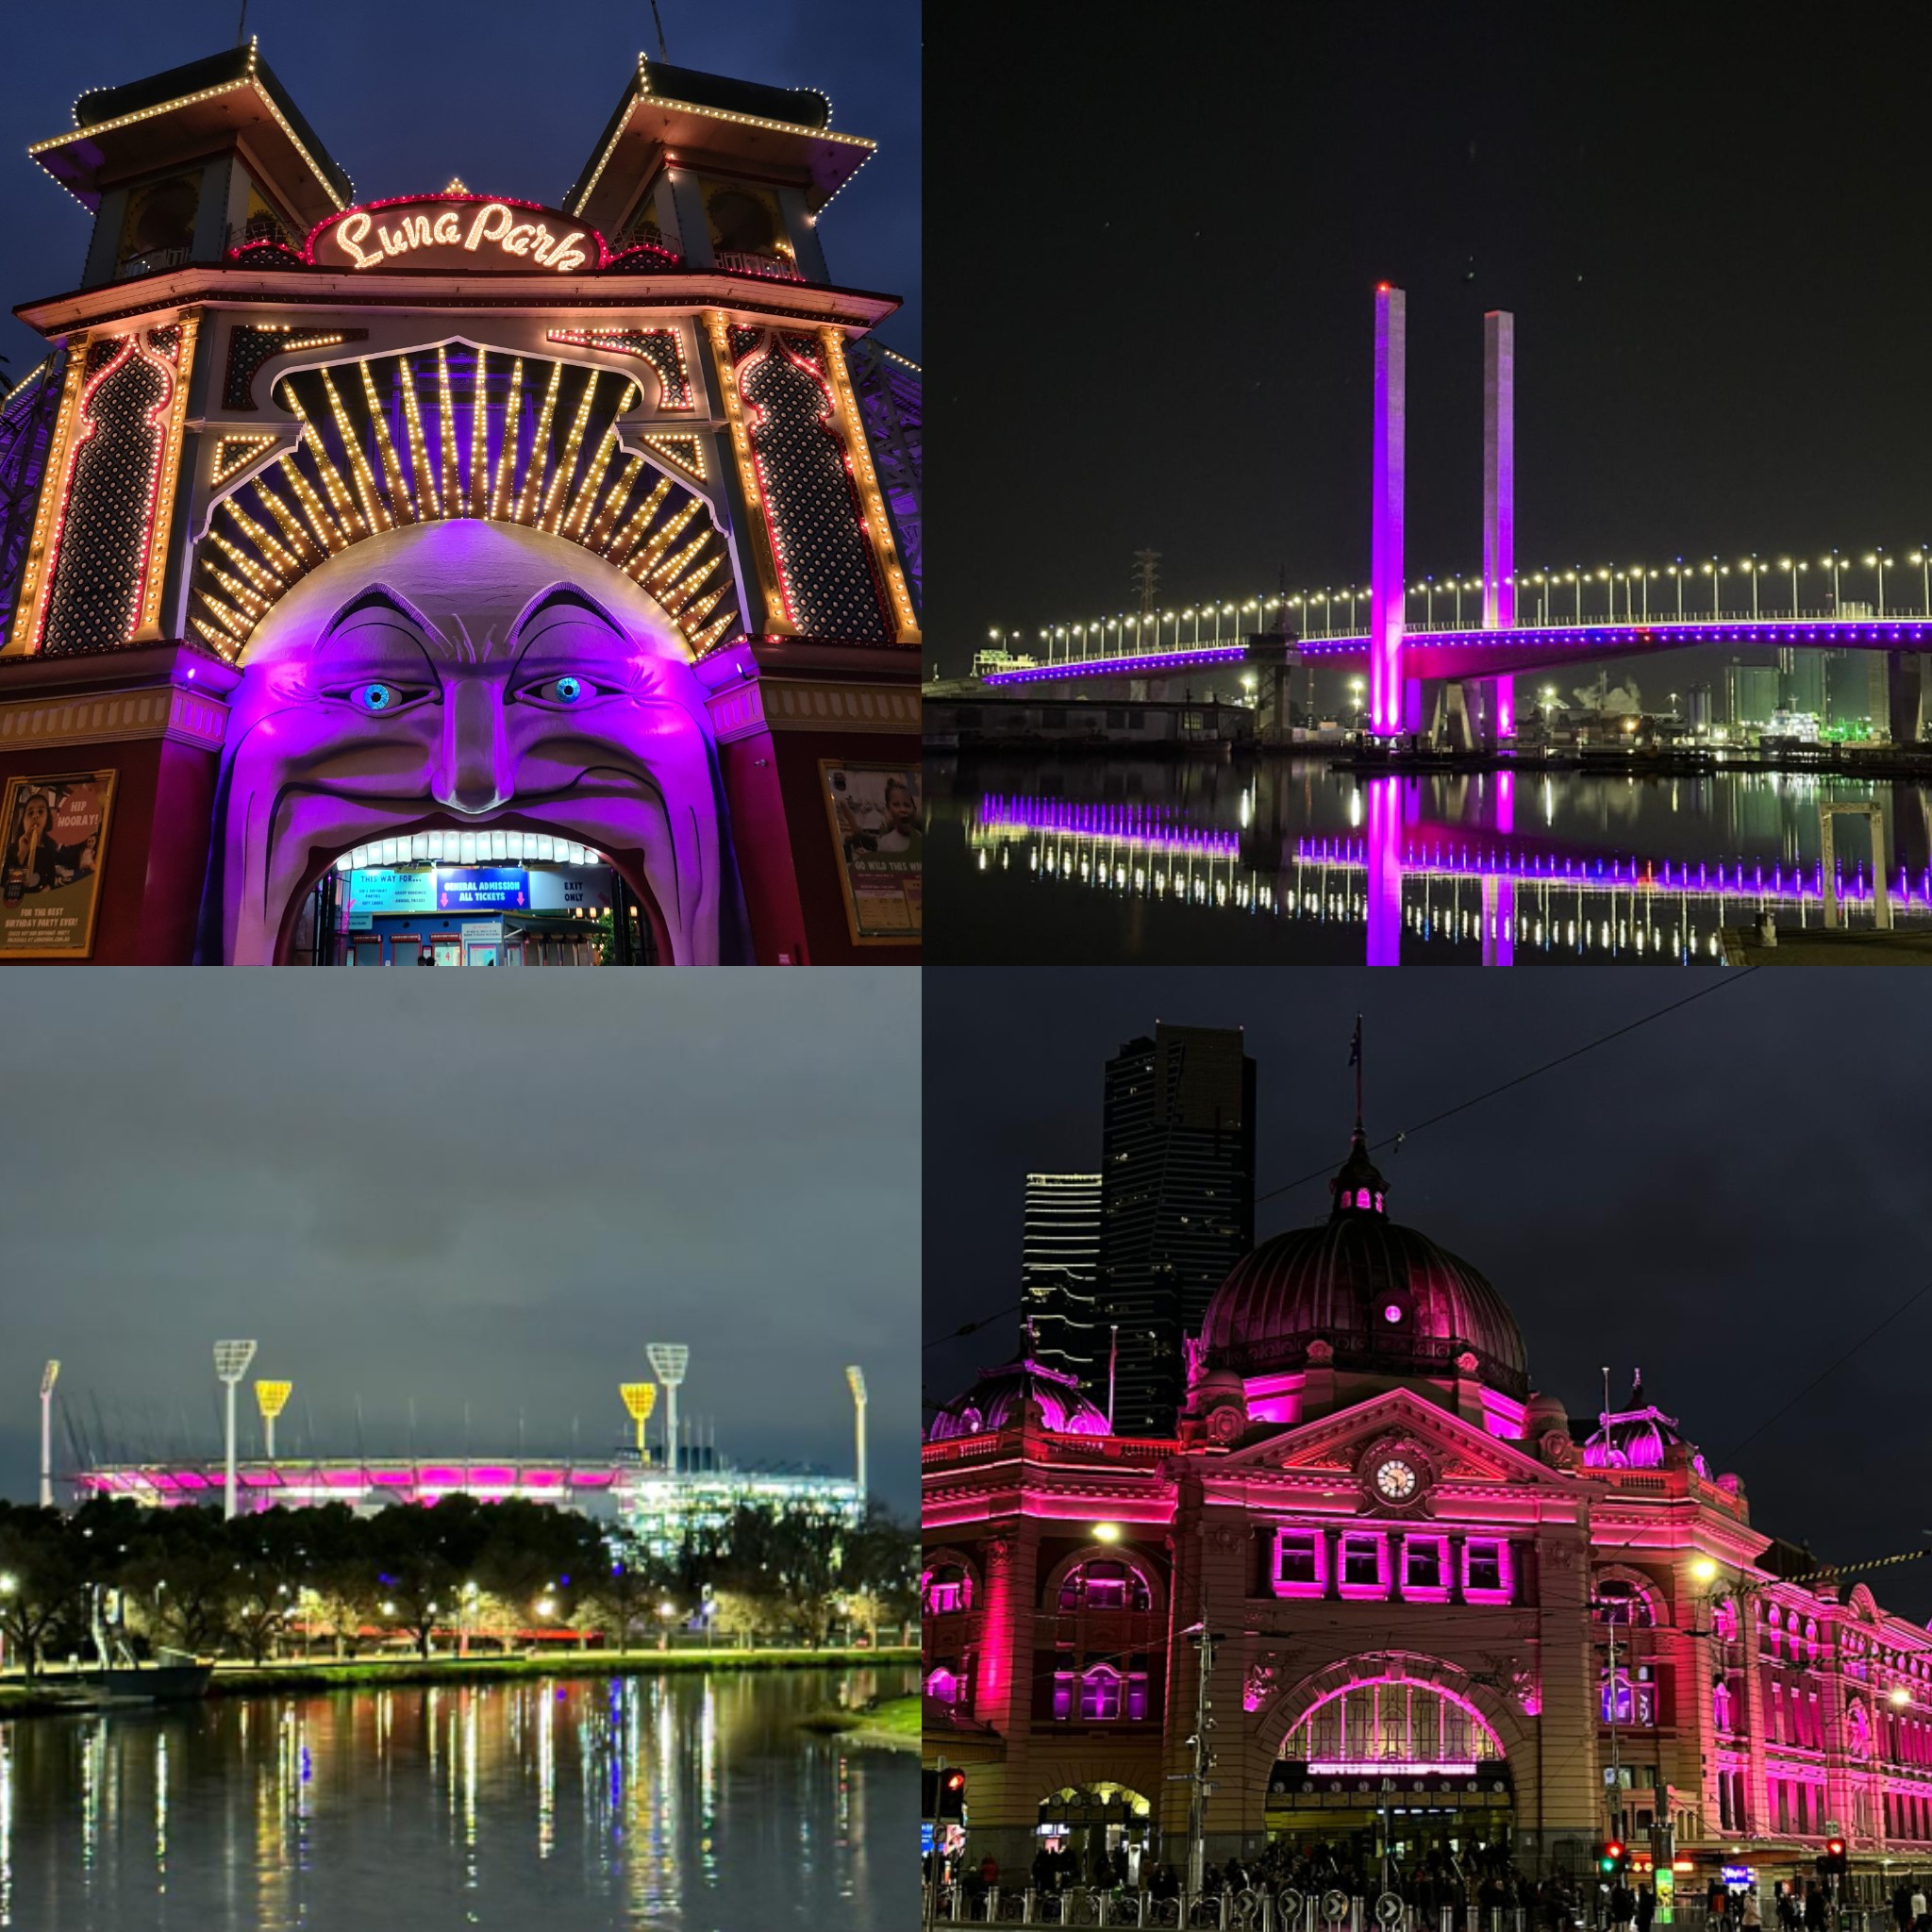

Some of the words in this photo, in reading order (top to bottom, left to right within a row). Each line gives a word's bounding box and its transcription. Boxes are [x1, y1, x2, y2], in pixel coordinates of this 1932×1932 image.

[336, 211, 461, 269] Luna
[462, 203, 586, 271] Park
[71, 801, 87, 812] HIP
[58, 814, 99, 826] HOORAY!
[855, 861, 866, 870] GO
[889, 862, 908, 871] THIS
[444, 882, 476, 891] GENERAL
[478, 881, 520, 891] ADMISSION
[564, 881, 582, 891] EXIT
[458, 891, 473, 902] ALL
[474, 891, 506, 902] TICKETS
[564, 892, 584, 902] ONLY
[21, 908, 33, 917] FOR
[34, 908, 46, 916] THE
[47, 908, 64, 916] BEST
[5, 919, 37, 928] BIRTHDAY
[37, 918, 58, 927] PARTY
[59, 917, 78, 926] EVER!
